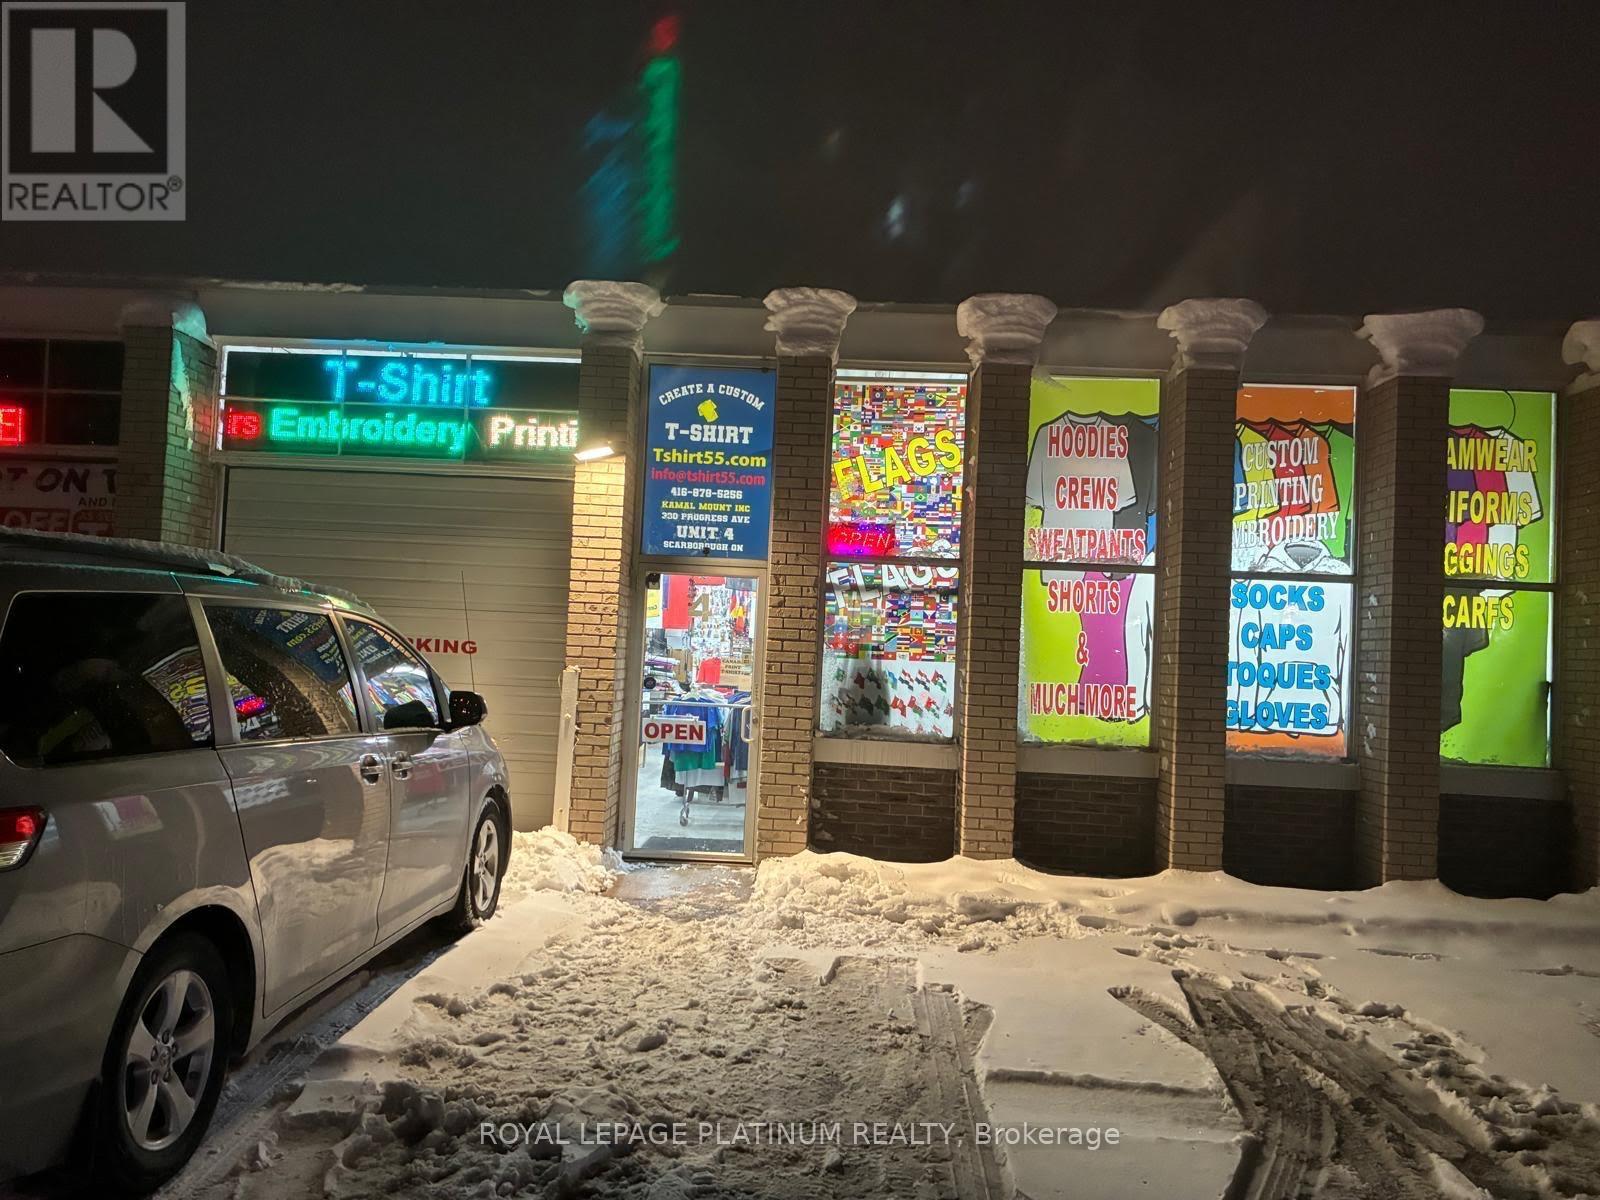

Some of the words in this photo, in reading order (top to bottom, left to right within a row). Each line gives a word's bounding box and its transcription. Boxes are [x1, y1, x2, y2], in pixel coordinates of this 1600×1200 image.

[323, 358, 491, 407] T-Shirt
[659, 383, 703, 406] CREATE
[707, 383, 715, 394] A
[718, 384, 765, 411] CUSTOM
[268, 407, 467, 457] Embroidery
[665, 422, 754, 445] T-SHIRT
[1047, 424, 1129, 460] HOODIES
[653, 447, 766, 468] Tshirt55.com
[833, 429, 962, 501] FLAGS
[1242, 436, 1319, 472] CUSTOM
[651, 467, 766, 486] info@tshirt55.com
[78, 497, 108, 508] AND
[661, 501, 696, 510] KAMAL
[698, 502, 732, 512] MOUNT
[734, 504, 751, 513] INC
[1055, 475, 1119, 511] CREWS
[1234, 474, 1324, 511] PRINTING
[676, 525, 719, 540] UNIT
[723, 527, 735, 541] 4
[681, 512, 728, 523] PROGRESS
[731, 515, 751, 524] AVE
[731, 543, 744, 552] ON
[1026, 527, 1146, 560] SWEATPANTS
[688, 593, 713, 622] 4
[1047, 579, 1121, 615] SHORTS
[1231, 582, 1326, 612] SOCKS
[1075, 630, 1089, 667] &
[1240, 621, 1314, 651] CAPS
[1226, 660, 1332, 691] TOQUES
[1029, 682, 1081, 716] MUCH
[1084, 683, 1137, 719] MORE
[1225, 699, 1328, 730] GLOVES
[644, 722, 704, 741] OPEN
